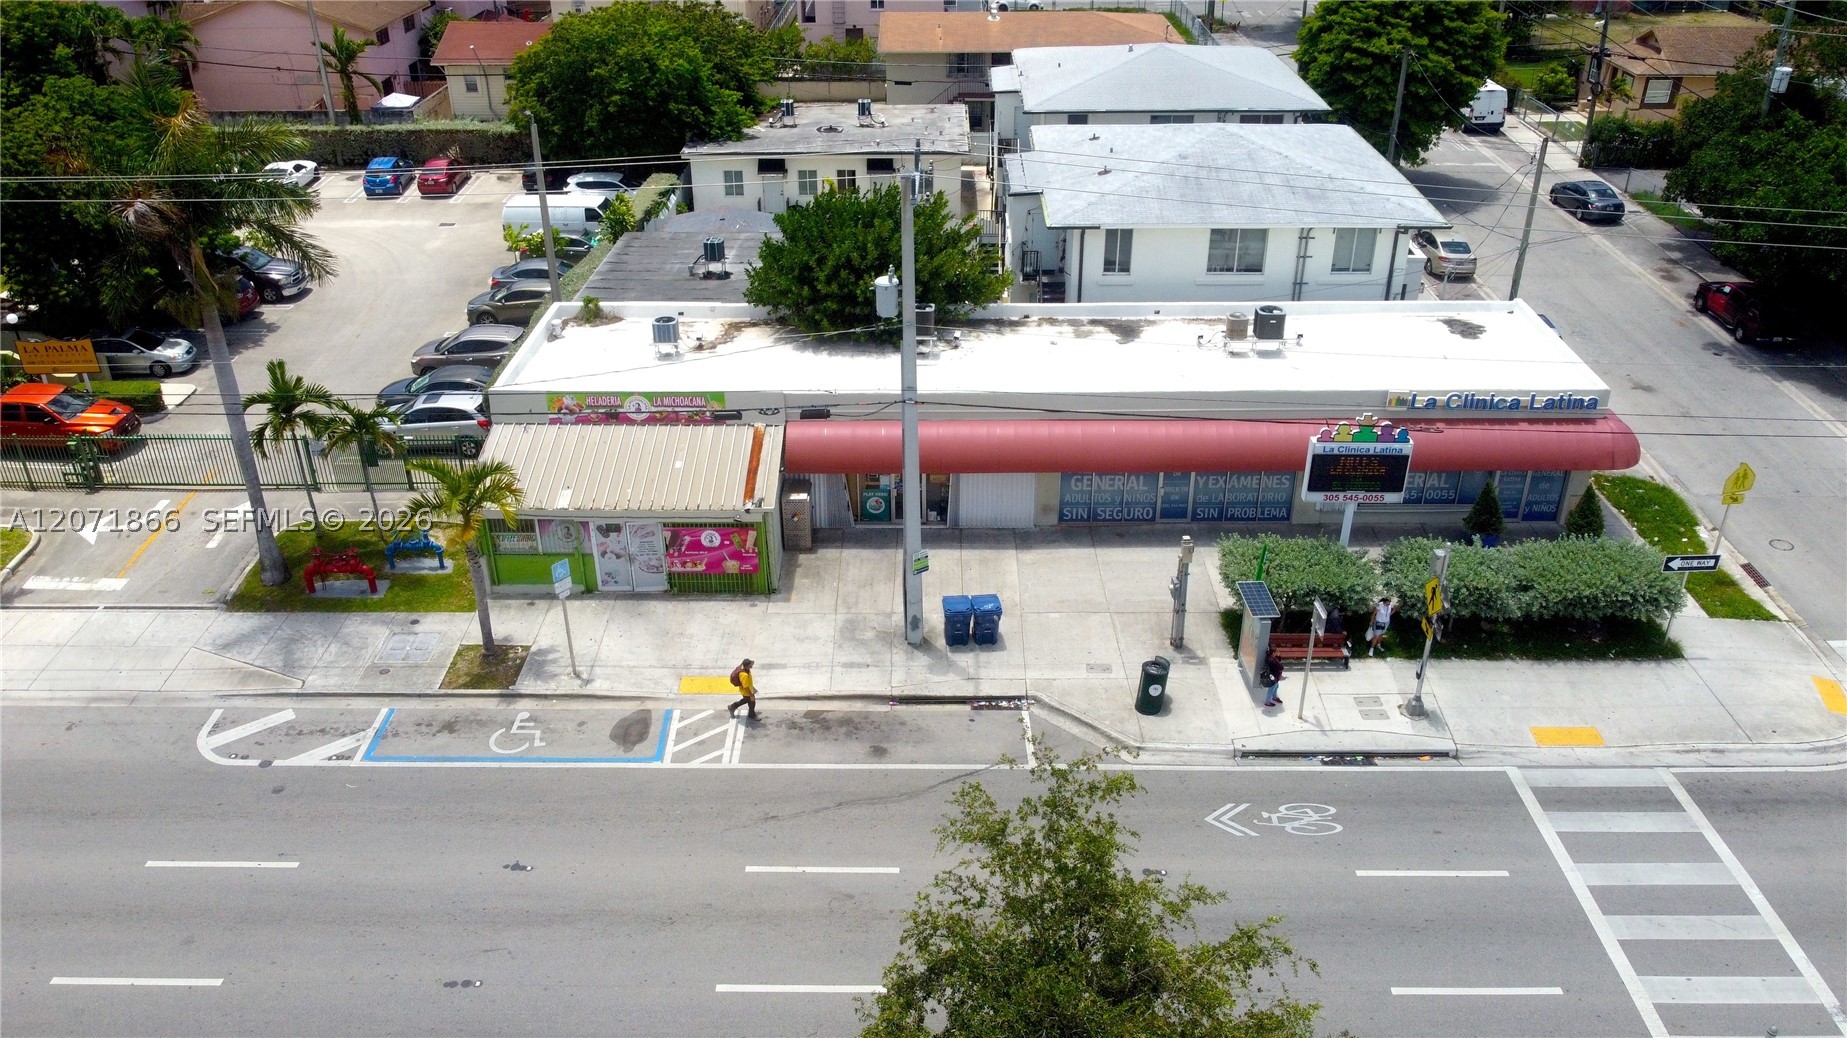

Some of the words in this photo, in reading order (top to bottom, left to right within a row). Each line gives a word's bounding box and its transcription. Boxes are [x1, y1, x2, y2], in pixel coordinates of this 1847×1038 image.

[23, 346, 40, 354] LA
[44, 344, 88, 353] PALMA
[585, 395, 622, 407] HELADERIA
[653, 396, 663, 407] LA
[663, 396, 706, 407] MICHOACANA
[1409, 391, 1438, 410] La
[1446, 391, 1521, 411] Clinica
[1528, 391, 1599, 410] Latina
[1337, 445, 1371, 454] Clinica
[1373, 446, 1404, 454] Latina
[1070, 475, 1148, 491] GENERAL
[1196, 475, 1207, 488] Y
[1208, 473, 1291, 488] EXÁMENES
[1406, 473, 1450, 488] ERAL
[1539, 481, 1550, 489] de
[1064, 493, 1111, 503] ADULTOS
[1114, 495, 1121, 505] y
[1196, 493, 1209, 503] de
[1212, 492, 1286, 502] LABORATORIO
[1342, 494, 1385, 502] 545-0055
[1404, 490, 1456, 500] 45-0055
[1196, 507, 1218, 518] SIN
[1227, 507, 1288, 518] PROBLEMA
[1531, 502, 1557, 513] NIÑOS
[1063, 507, 1088, 520] SIN
[1097, 507, 1153, 520] SEGURO
